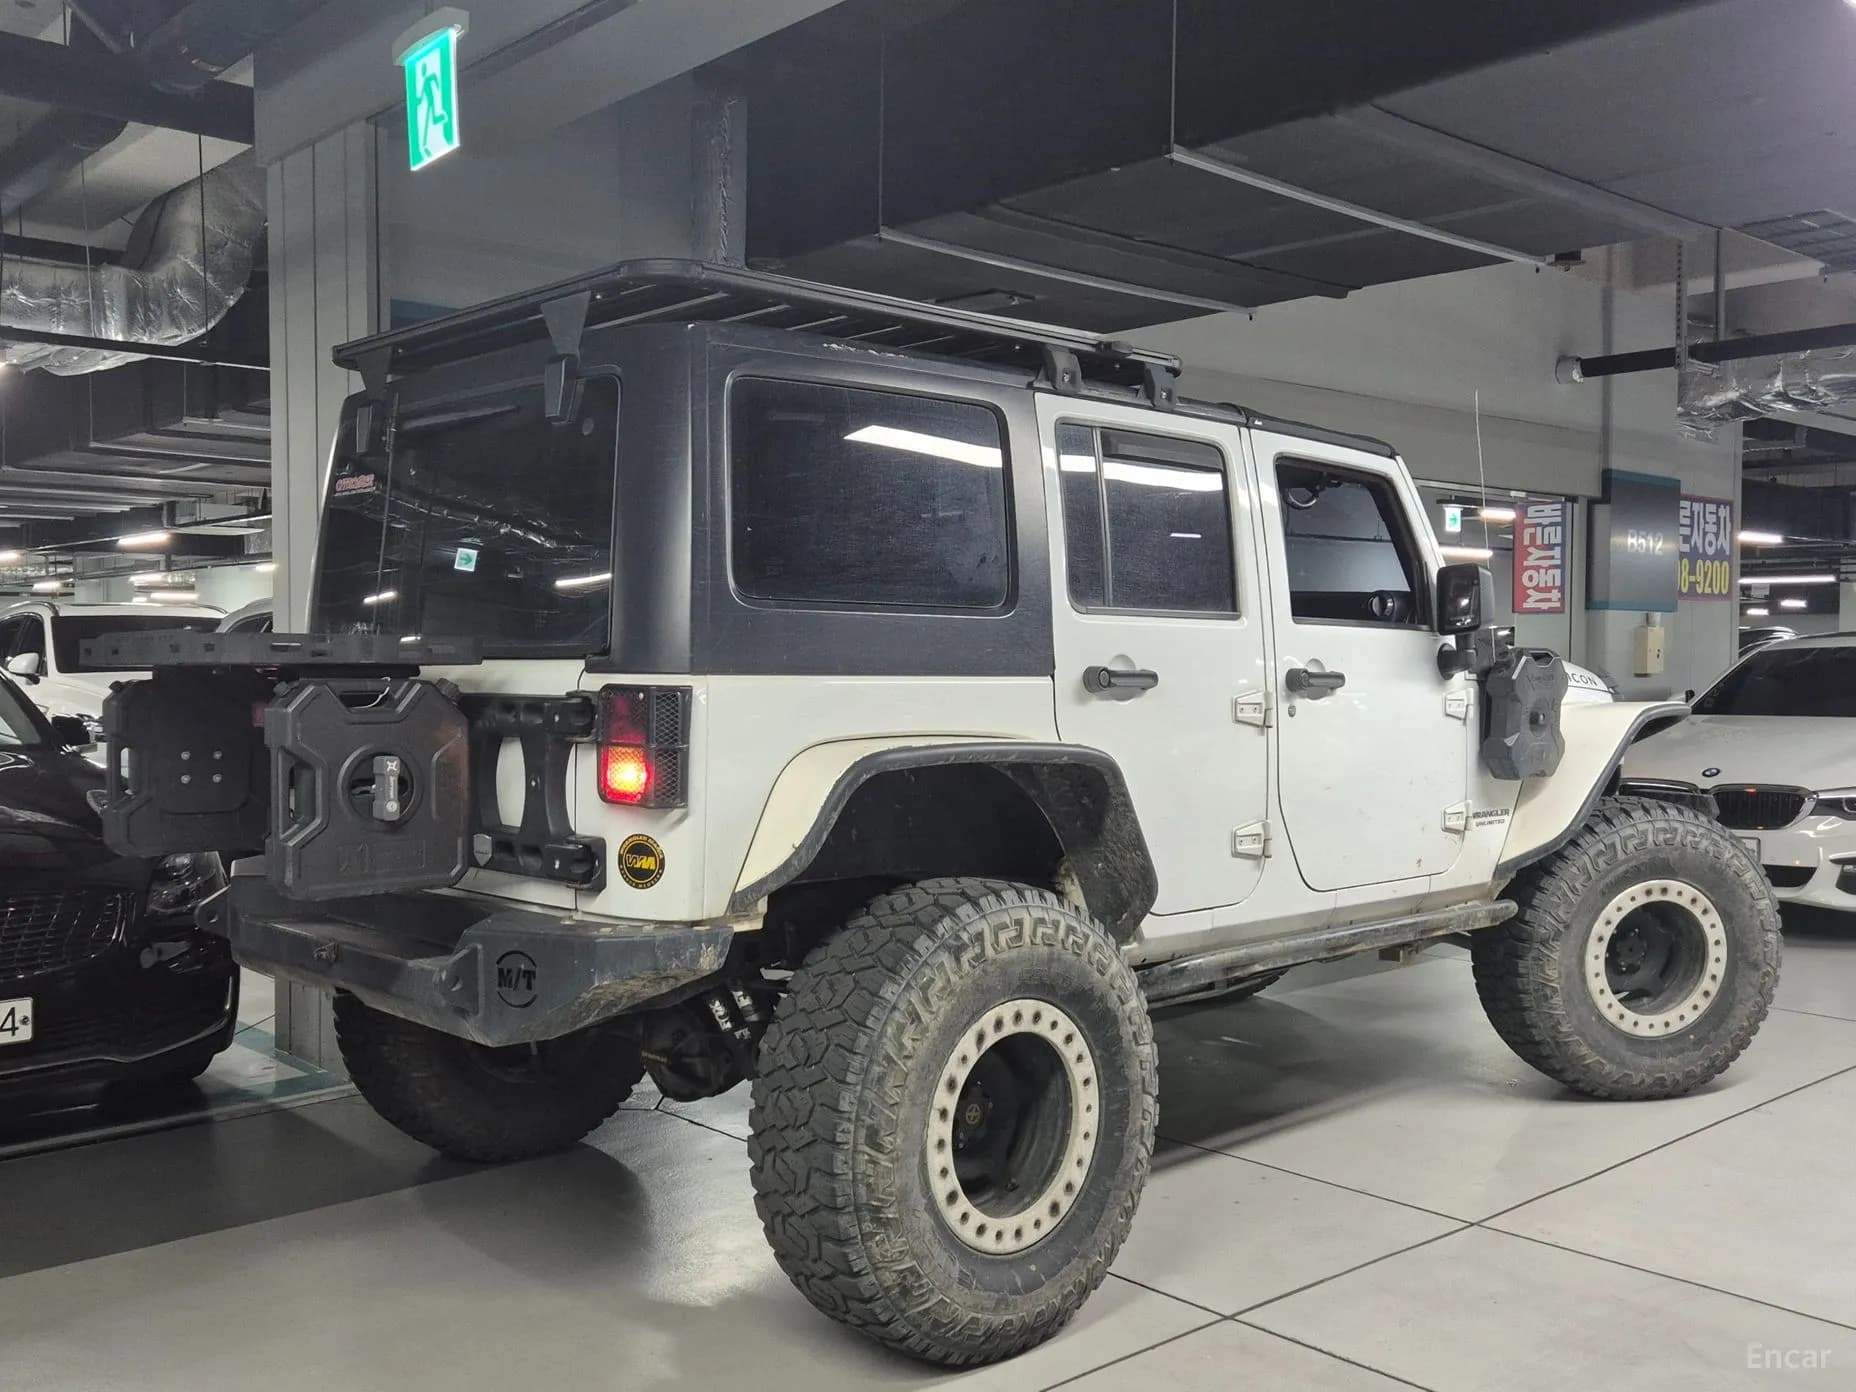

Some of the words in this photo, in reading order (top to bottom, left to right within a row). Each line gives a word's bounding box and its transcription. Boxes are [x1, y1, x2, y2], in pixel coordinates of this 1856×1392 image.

[1521, 503, 1562, 610] 바른자동차
[1627, 528, 1664, 556] B512
[1678, 558, 1729, 594] 8-9200
[497, 967, 537, 992] M/T
[0, 1006, 19, 1037] 4
